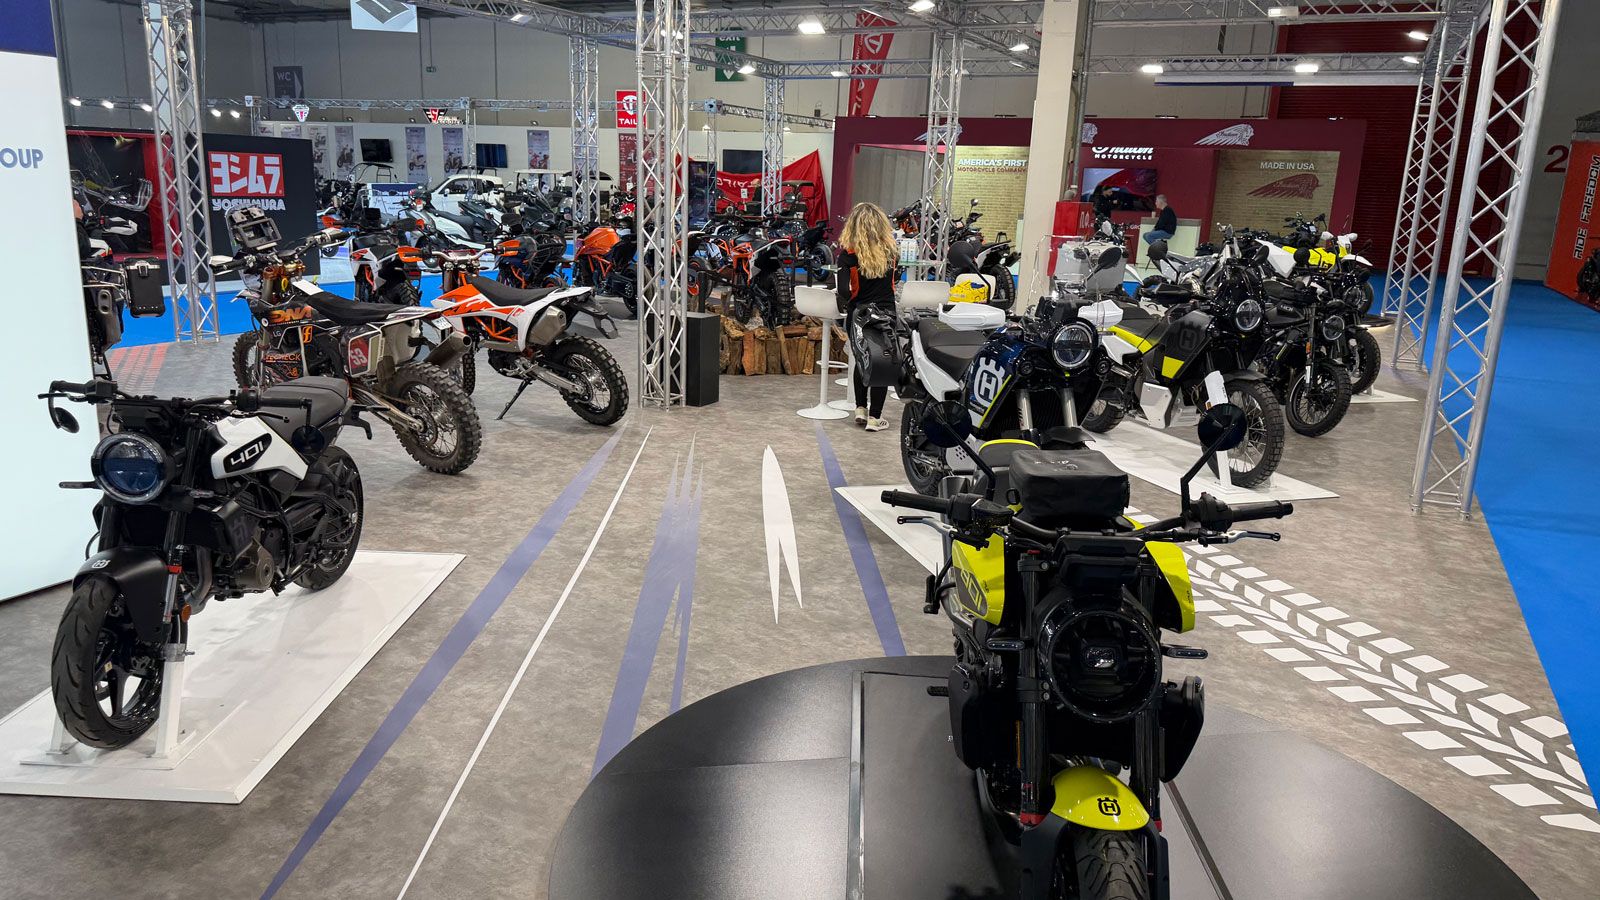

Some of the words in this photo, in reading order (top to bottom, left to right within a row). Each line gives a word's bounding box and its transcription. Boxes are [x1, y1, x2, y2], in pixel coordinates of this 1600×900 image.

[276, 71, 291, 81] WC
[0, 147, 44, 169] OUP
[1094, 153, 1153, 161] MOTORCYCLE
[959, 158, 1003, 167] AMERICA'S
[1004, 159, 1028, 167] FIRST
[1260, 162, 1285, 170] MADE
[1286, 162, 1295, 170] IN
[1297, 162, 1315, 170] USA
[1573, 227, 1587, 260] RIDE
[1580, 154, 1600, 223] FREEDOM
[230, 440, 264, 465] 401
